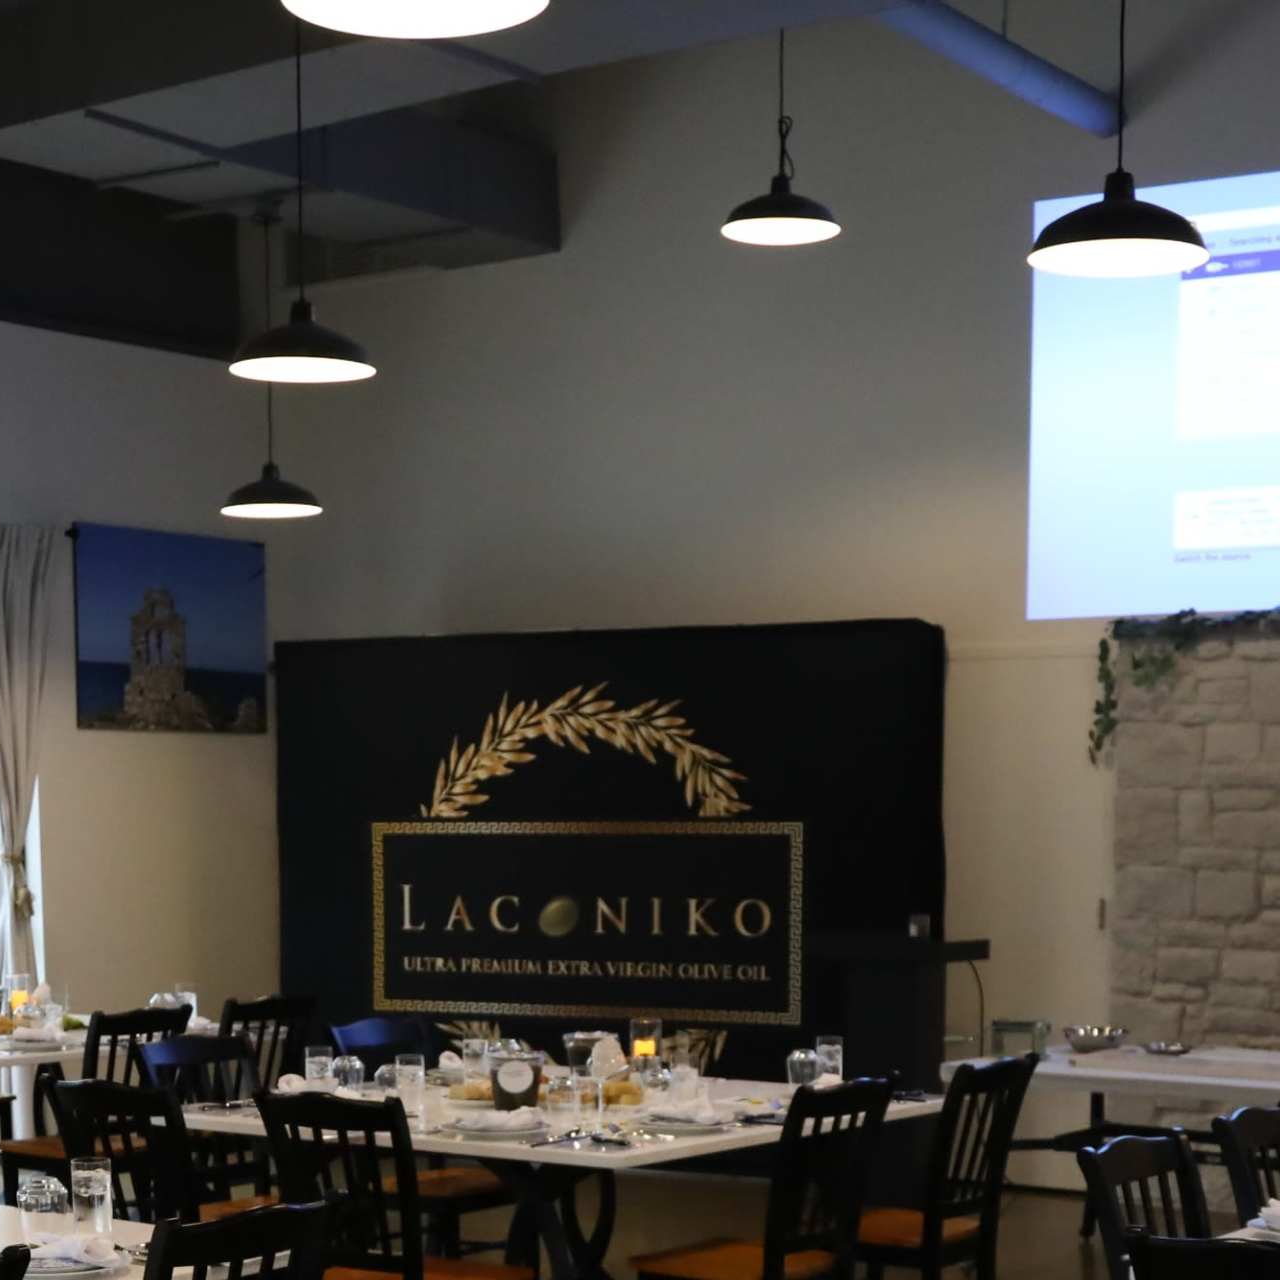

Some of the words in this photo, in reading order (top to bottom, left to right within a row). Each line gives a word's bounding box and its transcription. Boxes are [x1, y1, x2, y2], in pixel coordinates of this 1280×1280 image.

[403, 955, 456, 973] ULTRA
[460, 957, 542, 976] PREMIUM
[547, 959, 605, 977] EXTRA
[607, 961, 673, 978] VIRGIN
[678, 963, 733, 980] OLIVE
[737, 964, 771, 981] OIL
